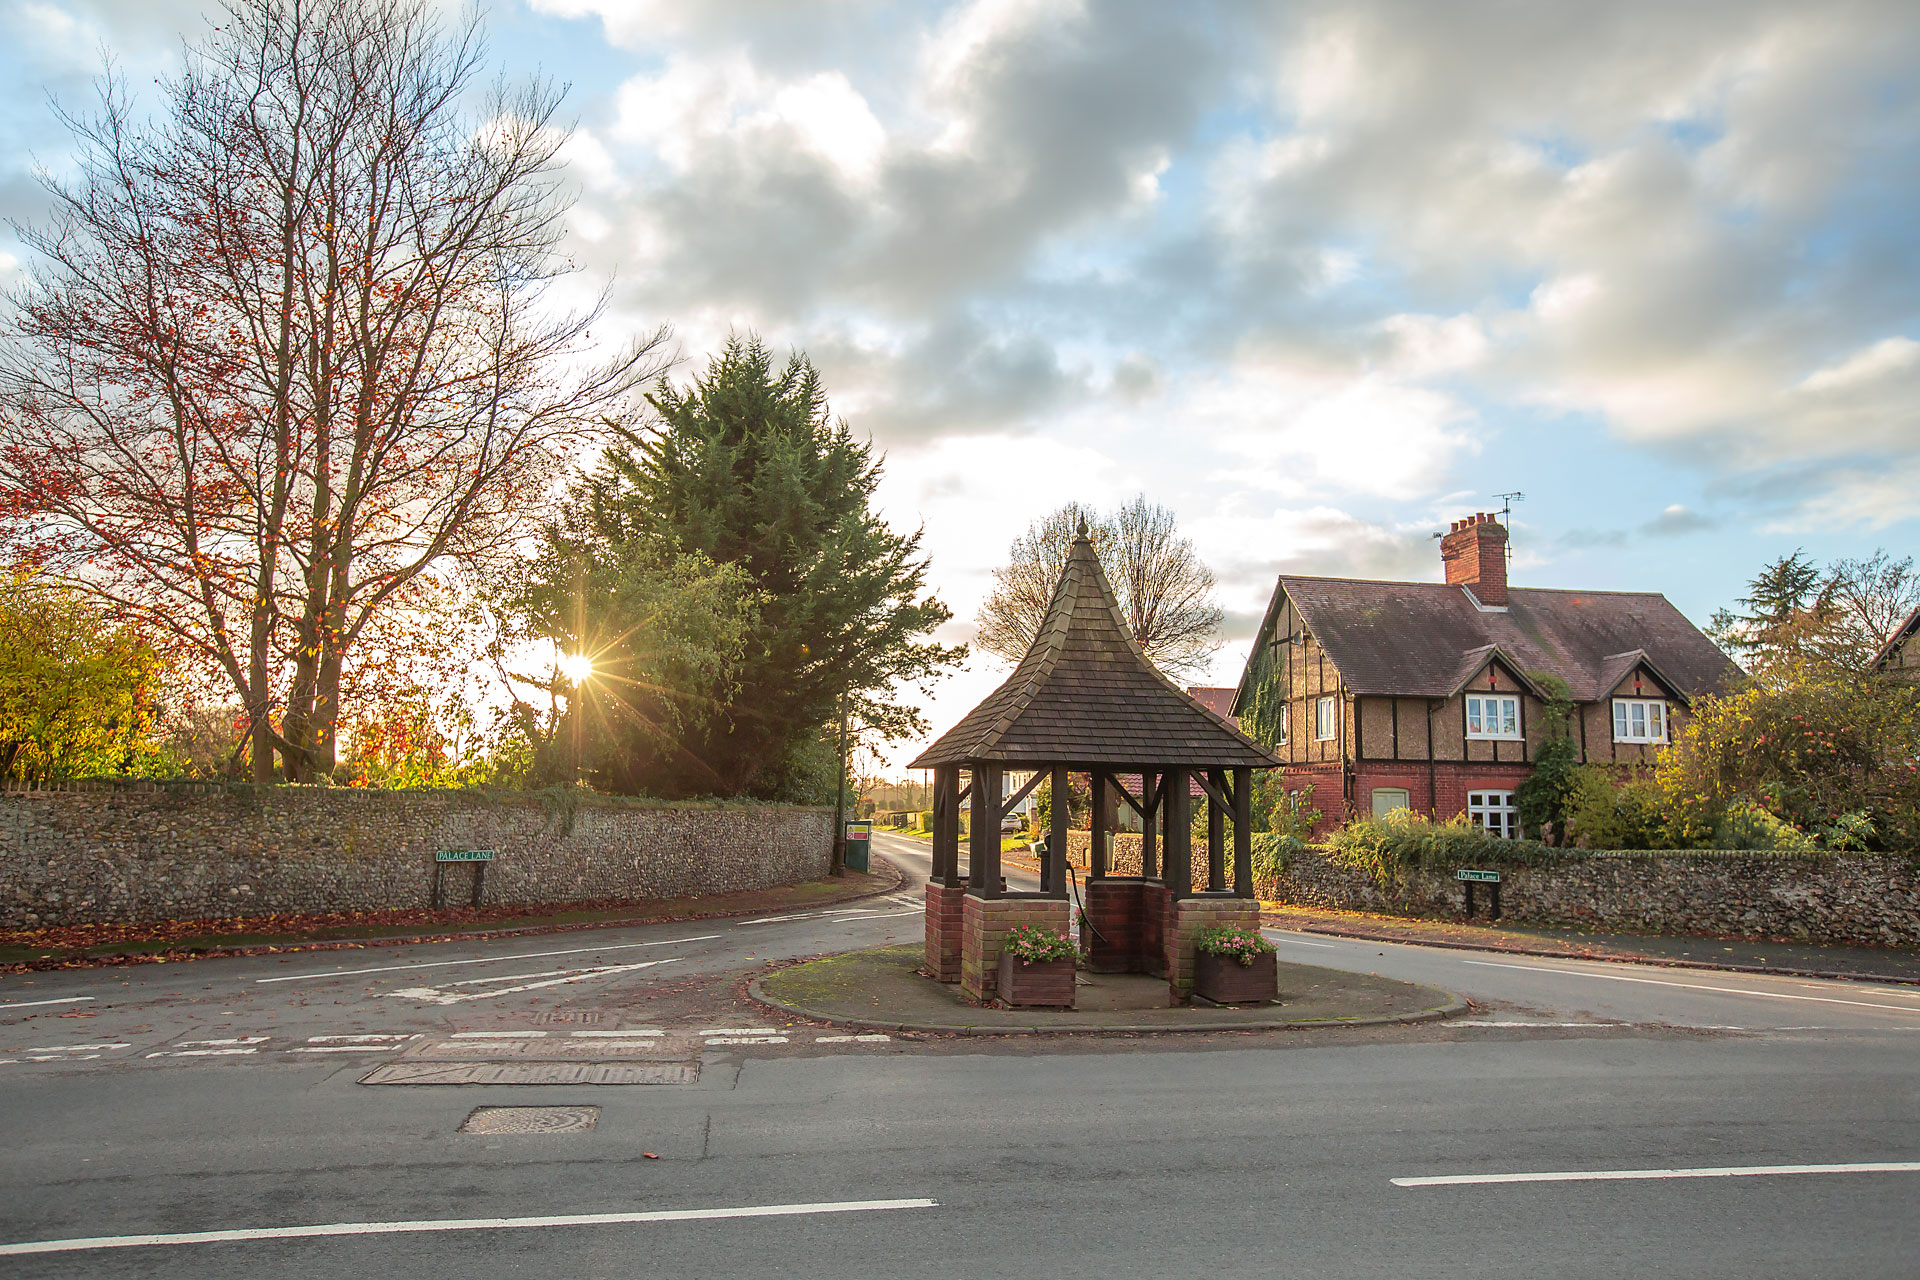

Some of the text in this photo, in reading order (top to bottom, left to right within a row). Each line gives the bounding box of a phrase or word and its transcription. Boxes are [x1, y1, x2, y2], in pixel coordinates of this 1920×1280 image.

[439, 851, 491, 860] PALACE LANE
[1460, 871, 1497, 880] Palace Lane
